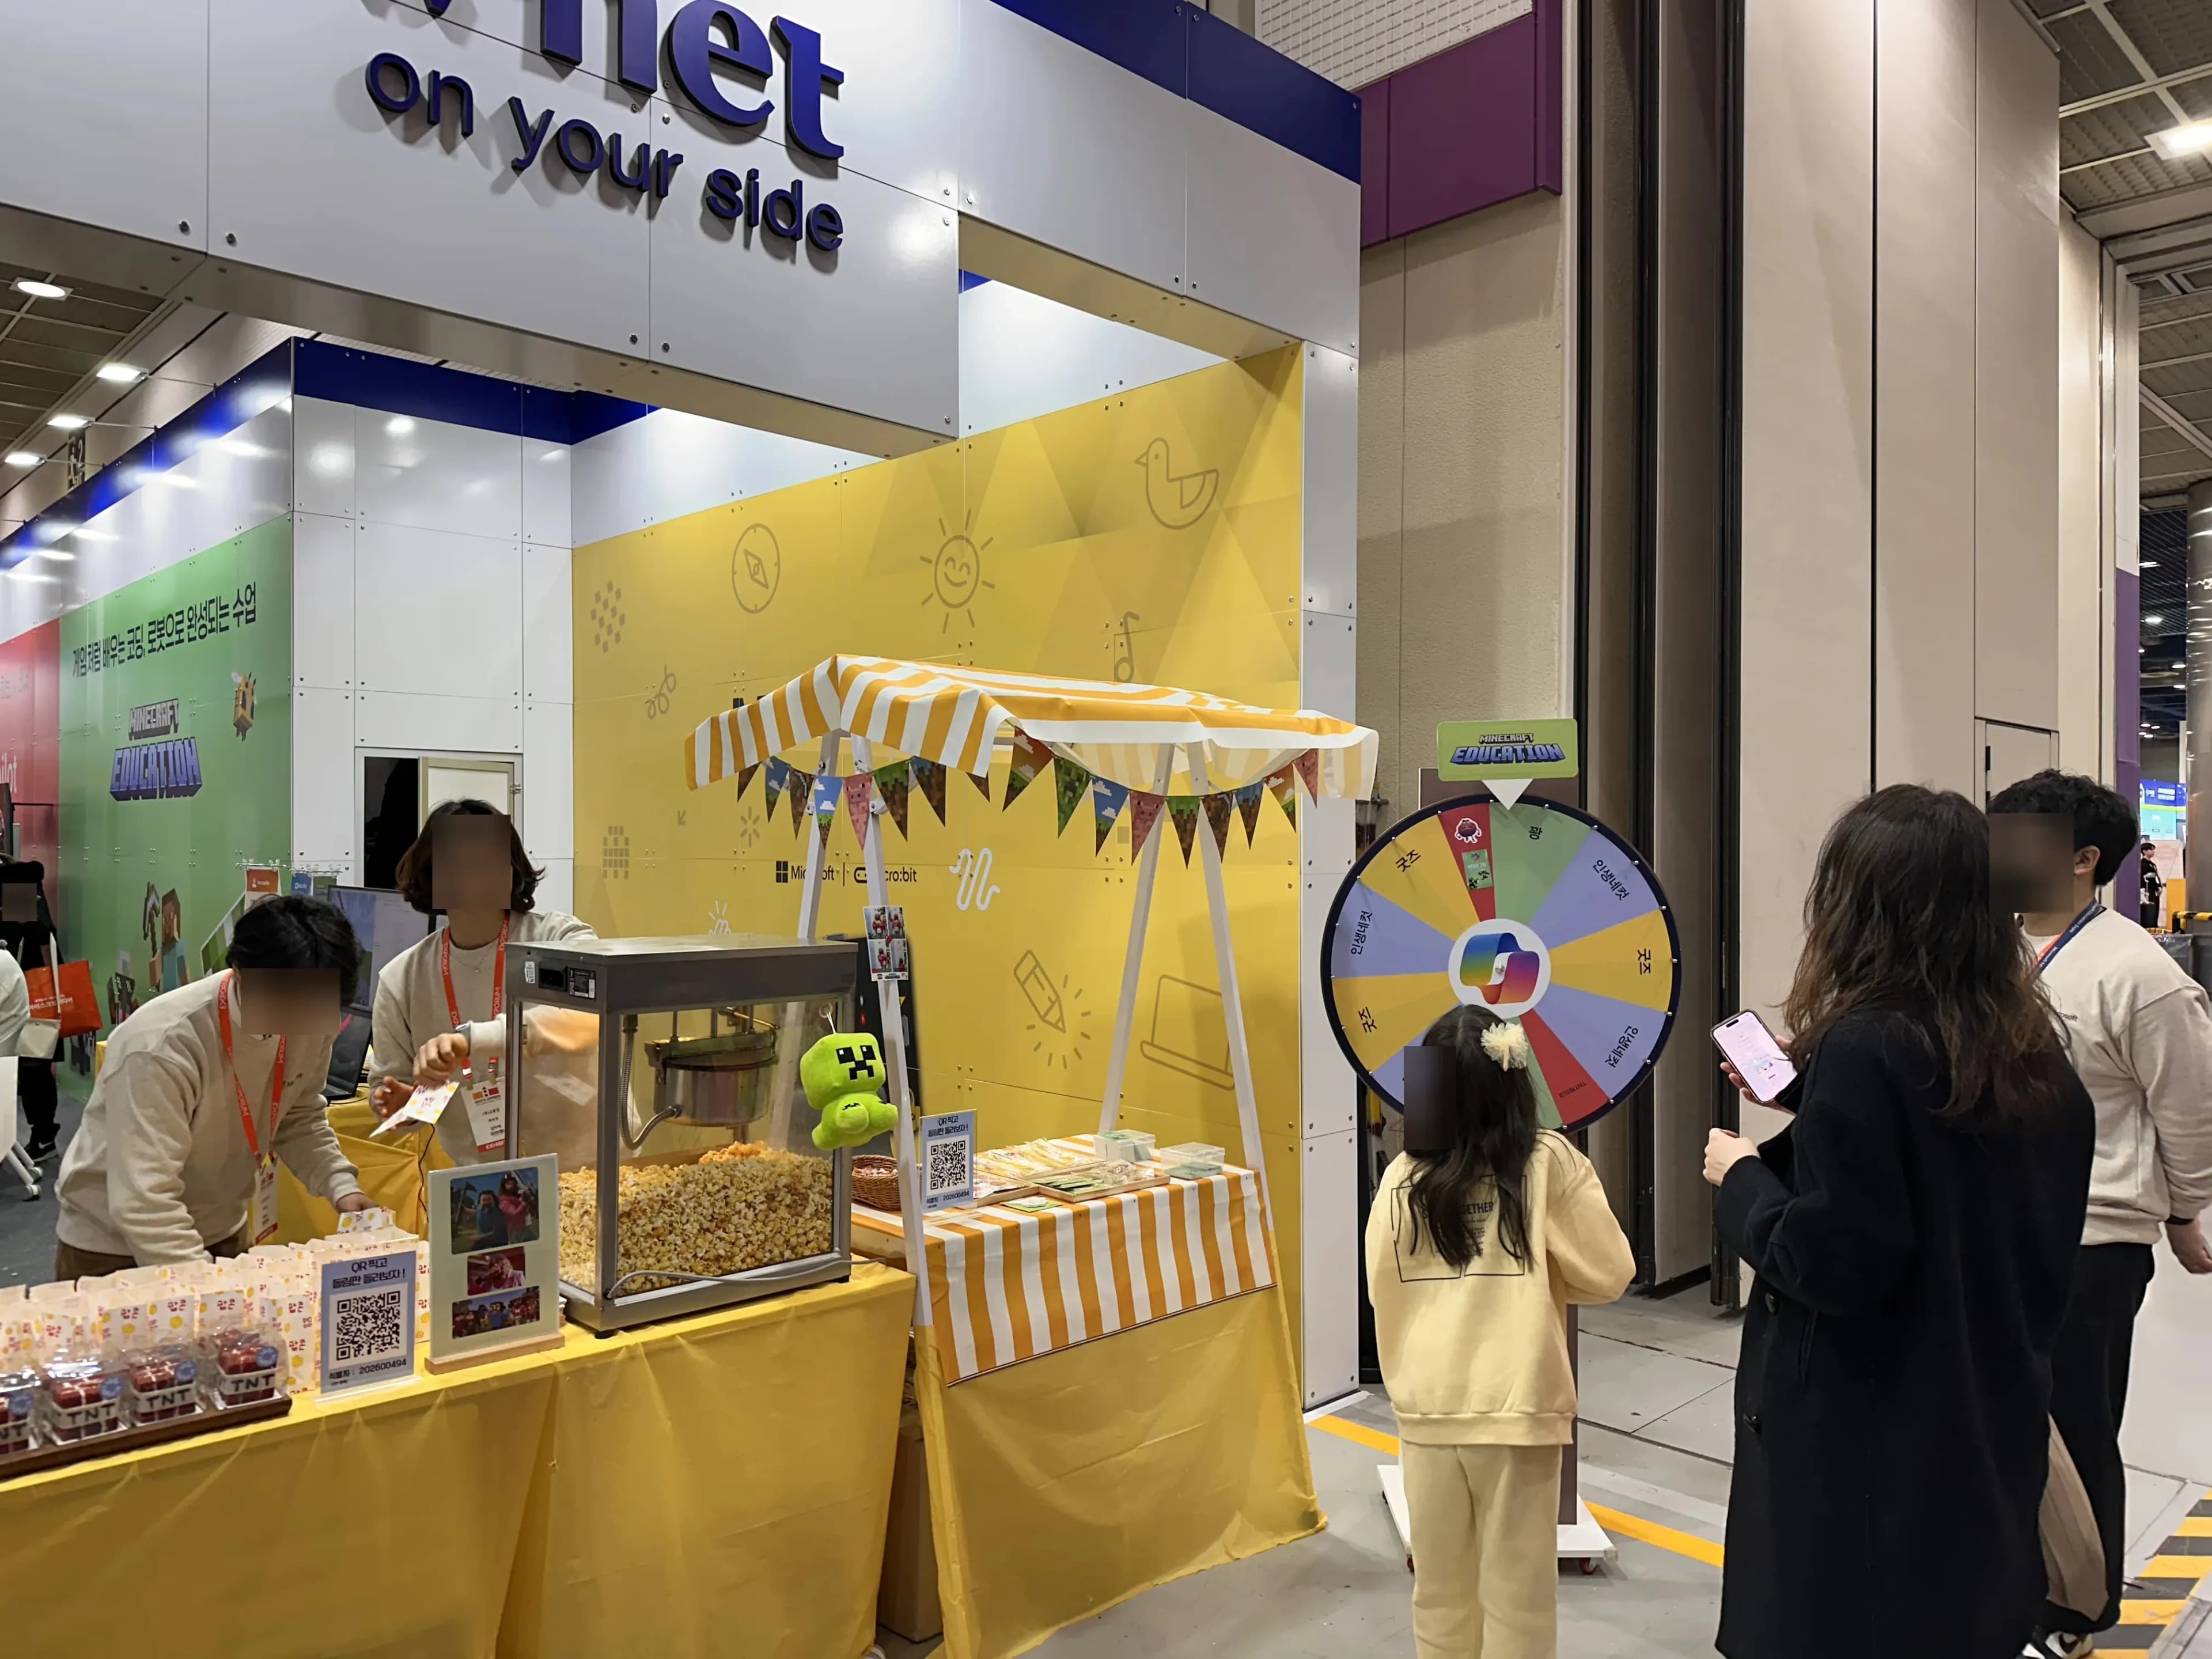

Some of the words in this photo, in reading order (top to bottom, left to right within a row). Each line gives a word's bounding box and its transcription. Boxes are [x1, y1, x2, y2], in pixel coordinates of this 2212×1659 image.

[365, 52, 474, 139] on
[507, 96, 684, 199] your
[706, 168, 843, 251] side
[73, 639, 101, 678] 게임처럼
[103, 633, 125, 668] 배우는
[127, 623, 146, 661] 코딩,
[147, 609, 184, 654] 로봇으로
[187, 594, 230, 643] 완성되는
[233, 581, 256, 628] 수업
[128, 698, 179, 741] MINECRAFT
[1479, 733, 1534, 744] MINECRAFT
[1450, 743, 1566, 765] EDUCATION
[110, 737, 202, 801] EDUCATION
[1528, 825, 1543, 840] 꽝
[1395, 849, 1421, 872] 굿즈
[791, 865, 835, 881] Micoft
[1593, 859, 1630, 901] 인생네컷
[1350, 910, 1373, 955] 인생네컷
[1637, 948, 1651, 975] 굿즈
[1358, 1006, 1377, 1033] 굿즈
[1605, 1025, 1639, 1068] 인생네컷
[938, 1118, 947, 1126] QR
[351, 1260, 367, 1273] QR
[368, 1257, 388, 1268] 찍고
[332, 1275, 362, 1289] 돌림판
[363, 1269, 401, 1285] 돌려보자
[329, 1369, 350, 1379] 식별자
[359, 1358, 407, 1374] 202600494
[230, 1373, 275, 1392] TNT
[146, 1388, 191, 1408] TNT
[66, 1402, 115, 1425] TNT
[0, 1422, 28, 1438] NT
